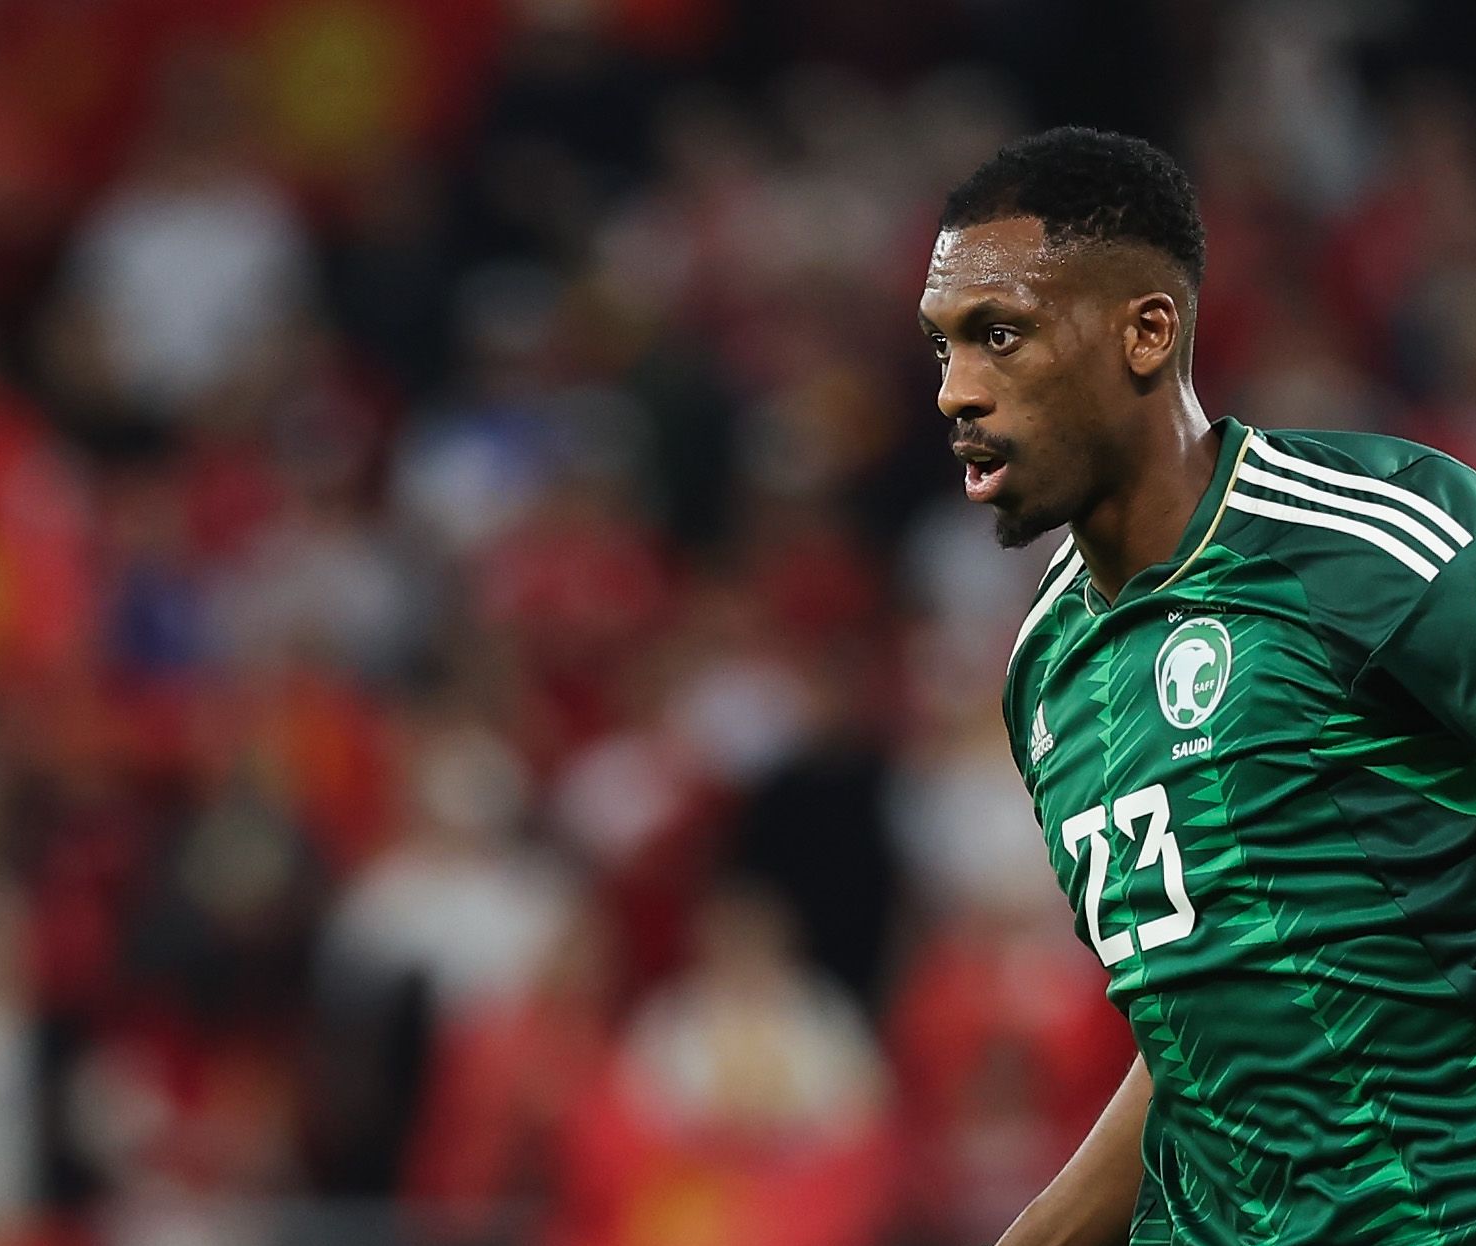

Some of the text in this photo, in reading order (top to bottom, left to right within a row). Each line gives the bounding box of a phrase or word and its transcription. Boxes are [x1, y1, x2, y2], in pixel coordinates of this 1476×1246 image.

[1193, 679, 1216, 695] SAFF
[1171, 735, 1213, 761] SAUDI
[1061, 783, 1196, 968] 23
